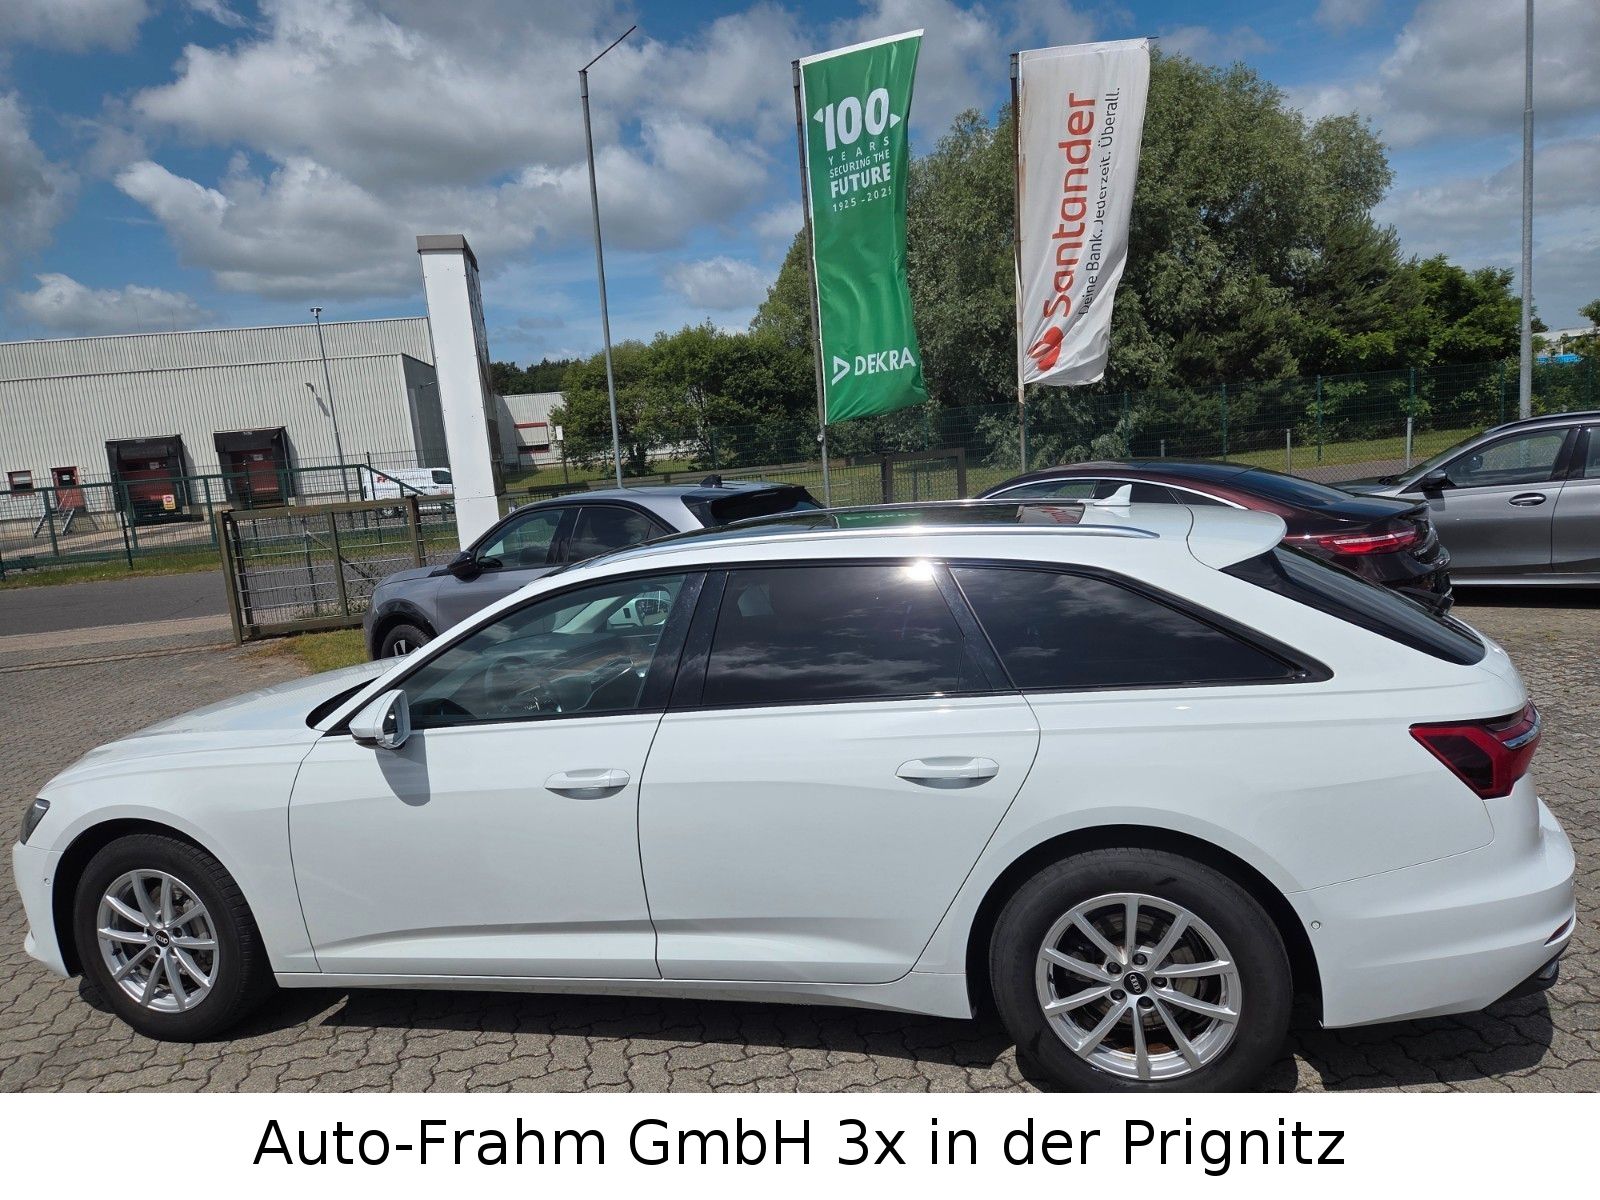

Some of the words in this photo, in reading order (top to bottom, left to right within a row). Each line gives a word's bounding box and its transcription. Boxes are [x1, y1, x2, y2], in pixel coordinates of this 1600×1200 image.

[824, 87, 890, 152] 100
[1098, 87, 1120, 148] Überall.
[828, 136, 890, 166] YEARS
[829, 156, 871, 179] SECURING
[873, 148, 890, 163] THE
[830, 162, 891, 199] FUTURE
[1094, 151, 1112, 225] Jederzeit.
[1043, 92, 1096, 318] Santander
[1086, 229, 1104, 271] Bank.
[1078, 275, 1098, 315] Deine
[854, 346, 917, 376] DEKRA
